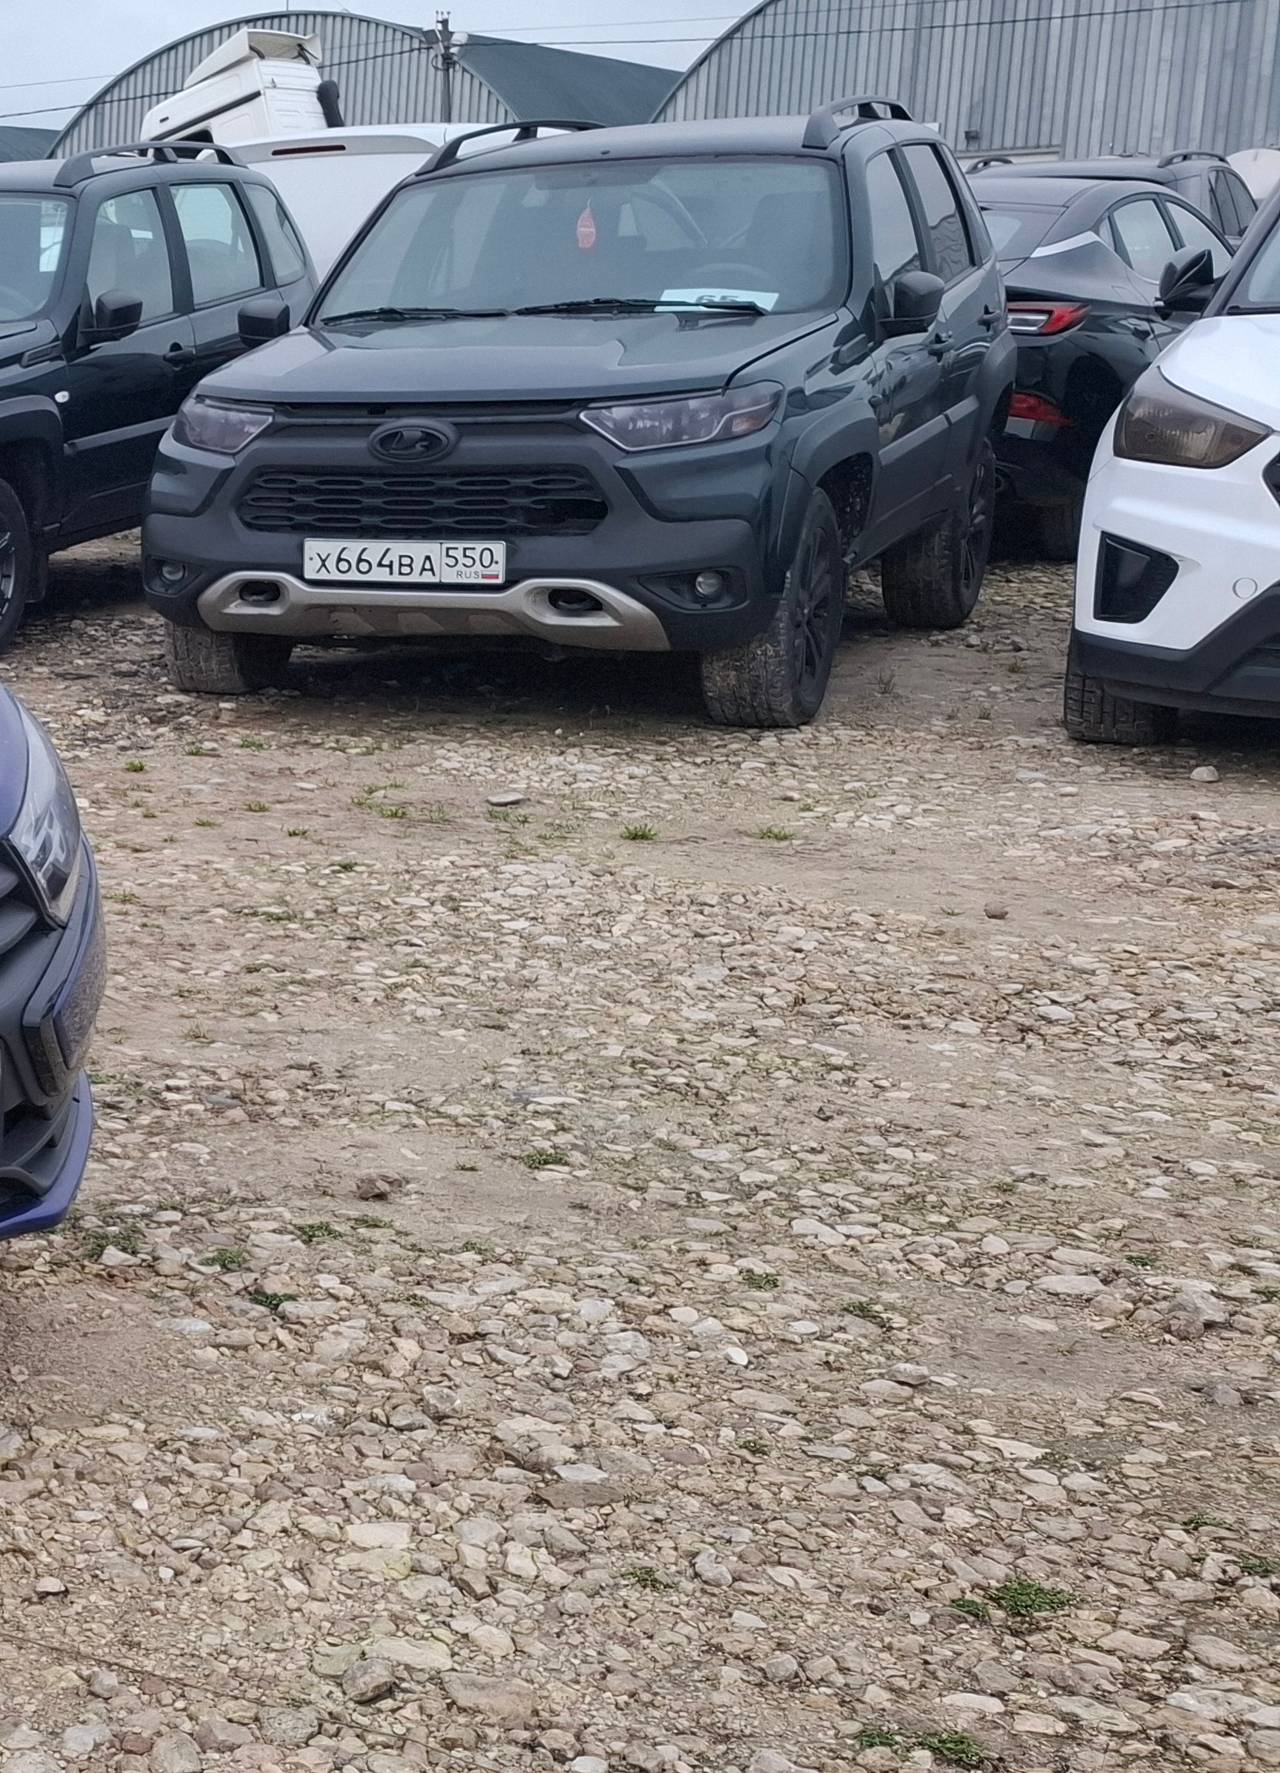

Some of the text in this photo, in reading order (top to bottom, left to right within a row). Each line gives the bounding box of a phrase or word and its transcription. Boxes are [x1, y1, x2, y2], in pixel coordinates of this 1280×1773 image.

[315, 547, 495, 577] Х664ВА 550
[456, 570, 480, 580] RUS
